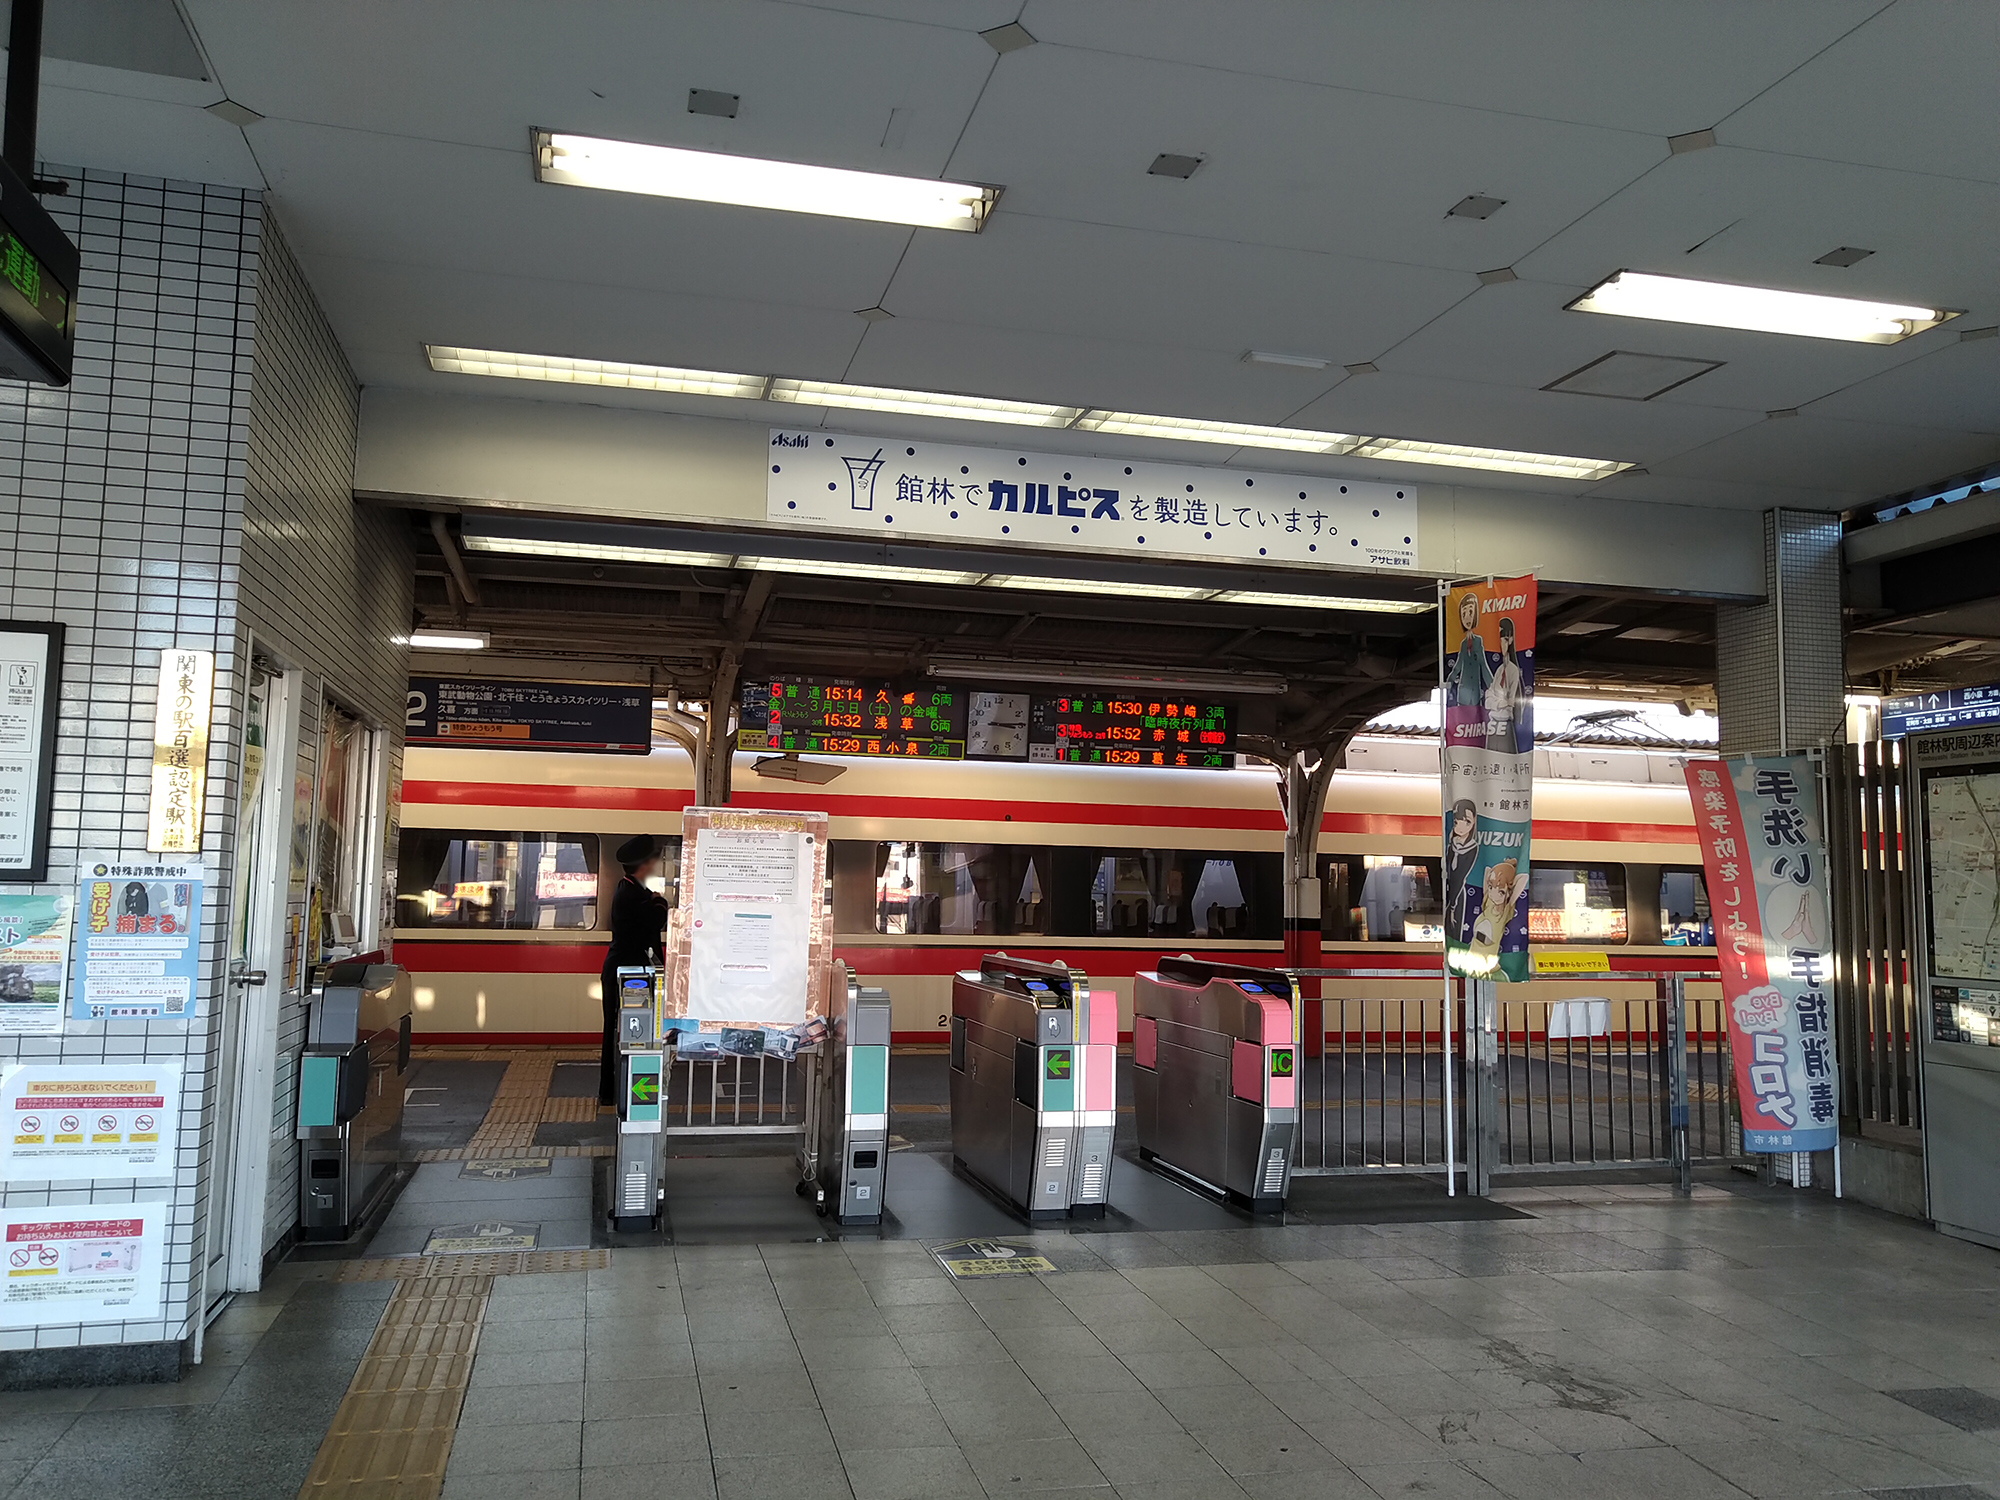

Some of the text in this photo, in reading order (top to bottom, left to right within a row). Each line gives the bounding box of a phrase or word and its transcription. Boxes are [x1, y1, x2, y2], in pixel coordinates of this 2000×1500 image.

[771, 432, 810, 450] Asahi
[1369, 555, 1410, 567] アサヒ飲料
[771, 683, 781, 697] 5
[785, 685, 821, 700] 普通
[825, 686, 863, 702] 15:14
[931, 693, 953, 707] 6両
[1918, 696, 1922, 710] 1
[406, 690, 427, 727] 2
[437, 705, 478, 715] 久喜 方面
[1058, 699, 1225, 719] 3 普通 15:30 伊勢崎 3両
[453, 724, 502, 733] 特急りょうもう号
[769, 710, 780, 724] 2
[823, 713, 862, 728] 15:32
[874, 715, 914, 732] 浅草
[930, 719, 951, 733] 6両
[1453, 721, 1508, 739] SHIRASE
[164, 654, 197, 826] 関東の駅百選認定駅
[1057, 724, 1067, 737] 3
[1106, 727, 1141, 742] 15:52
[1153, 729, 1190, 744] 赤城
[768, 736, 950, 757] 4 普通 15:29 西小泉 2両
[1057, 748, 1064, 761] 1
[1070, 749, 1101, 763] 普通
[1105, 750, 1140, 765] 15:29
[1152, 752, 1187, 767] 葛生
[1203, 755, 1222, 768] 2両
[1499, 799, 1529, 811] 館林市
[111, 866, 187, 878] 特殊詐欺警戒中
[90, 882, 112, 933] 受け子
[116, 914, 186, 935] 捕まる。
[938, 1015, 952, 1027] 2
[1271, 1052, 1292, 1073] IC
[1273, 1151, 1280, 1159] 3
[21, 1220, 131, 1232] キックボード・スケートボードの
